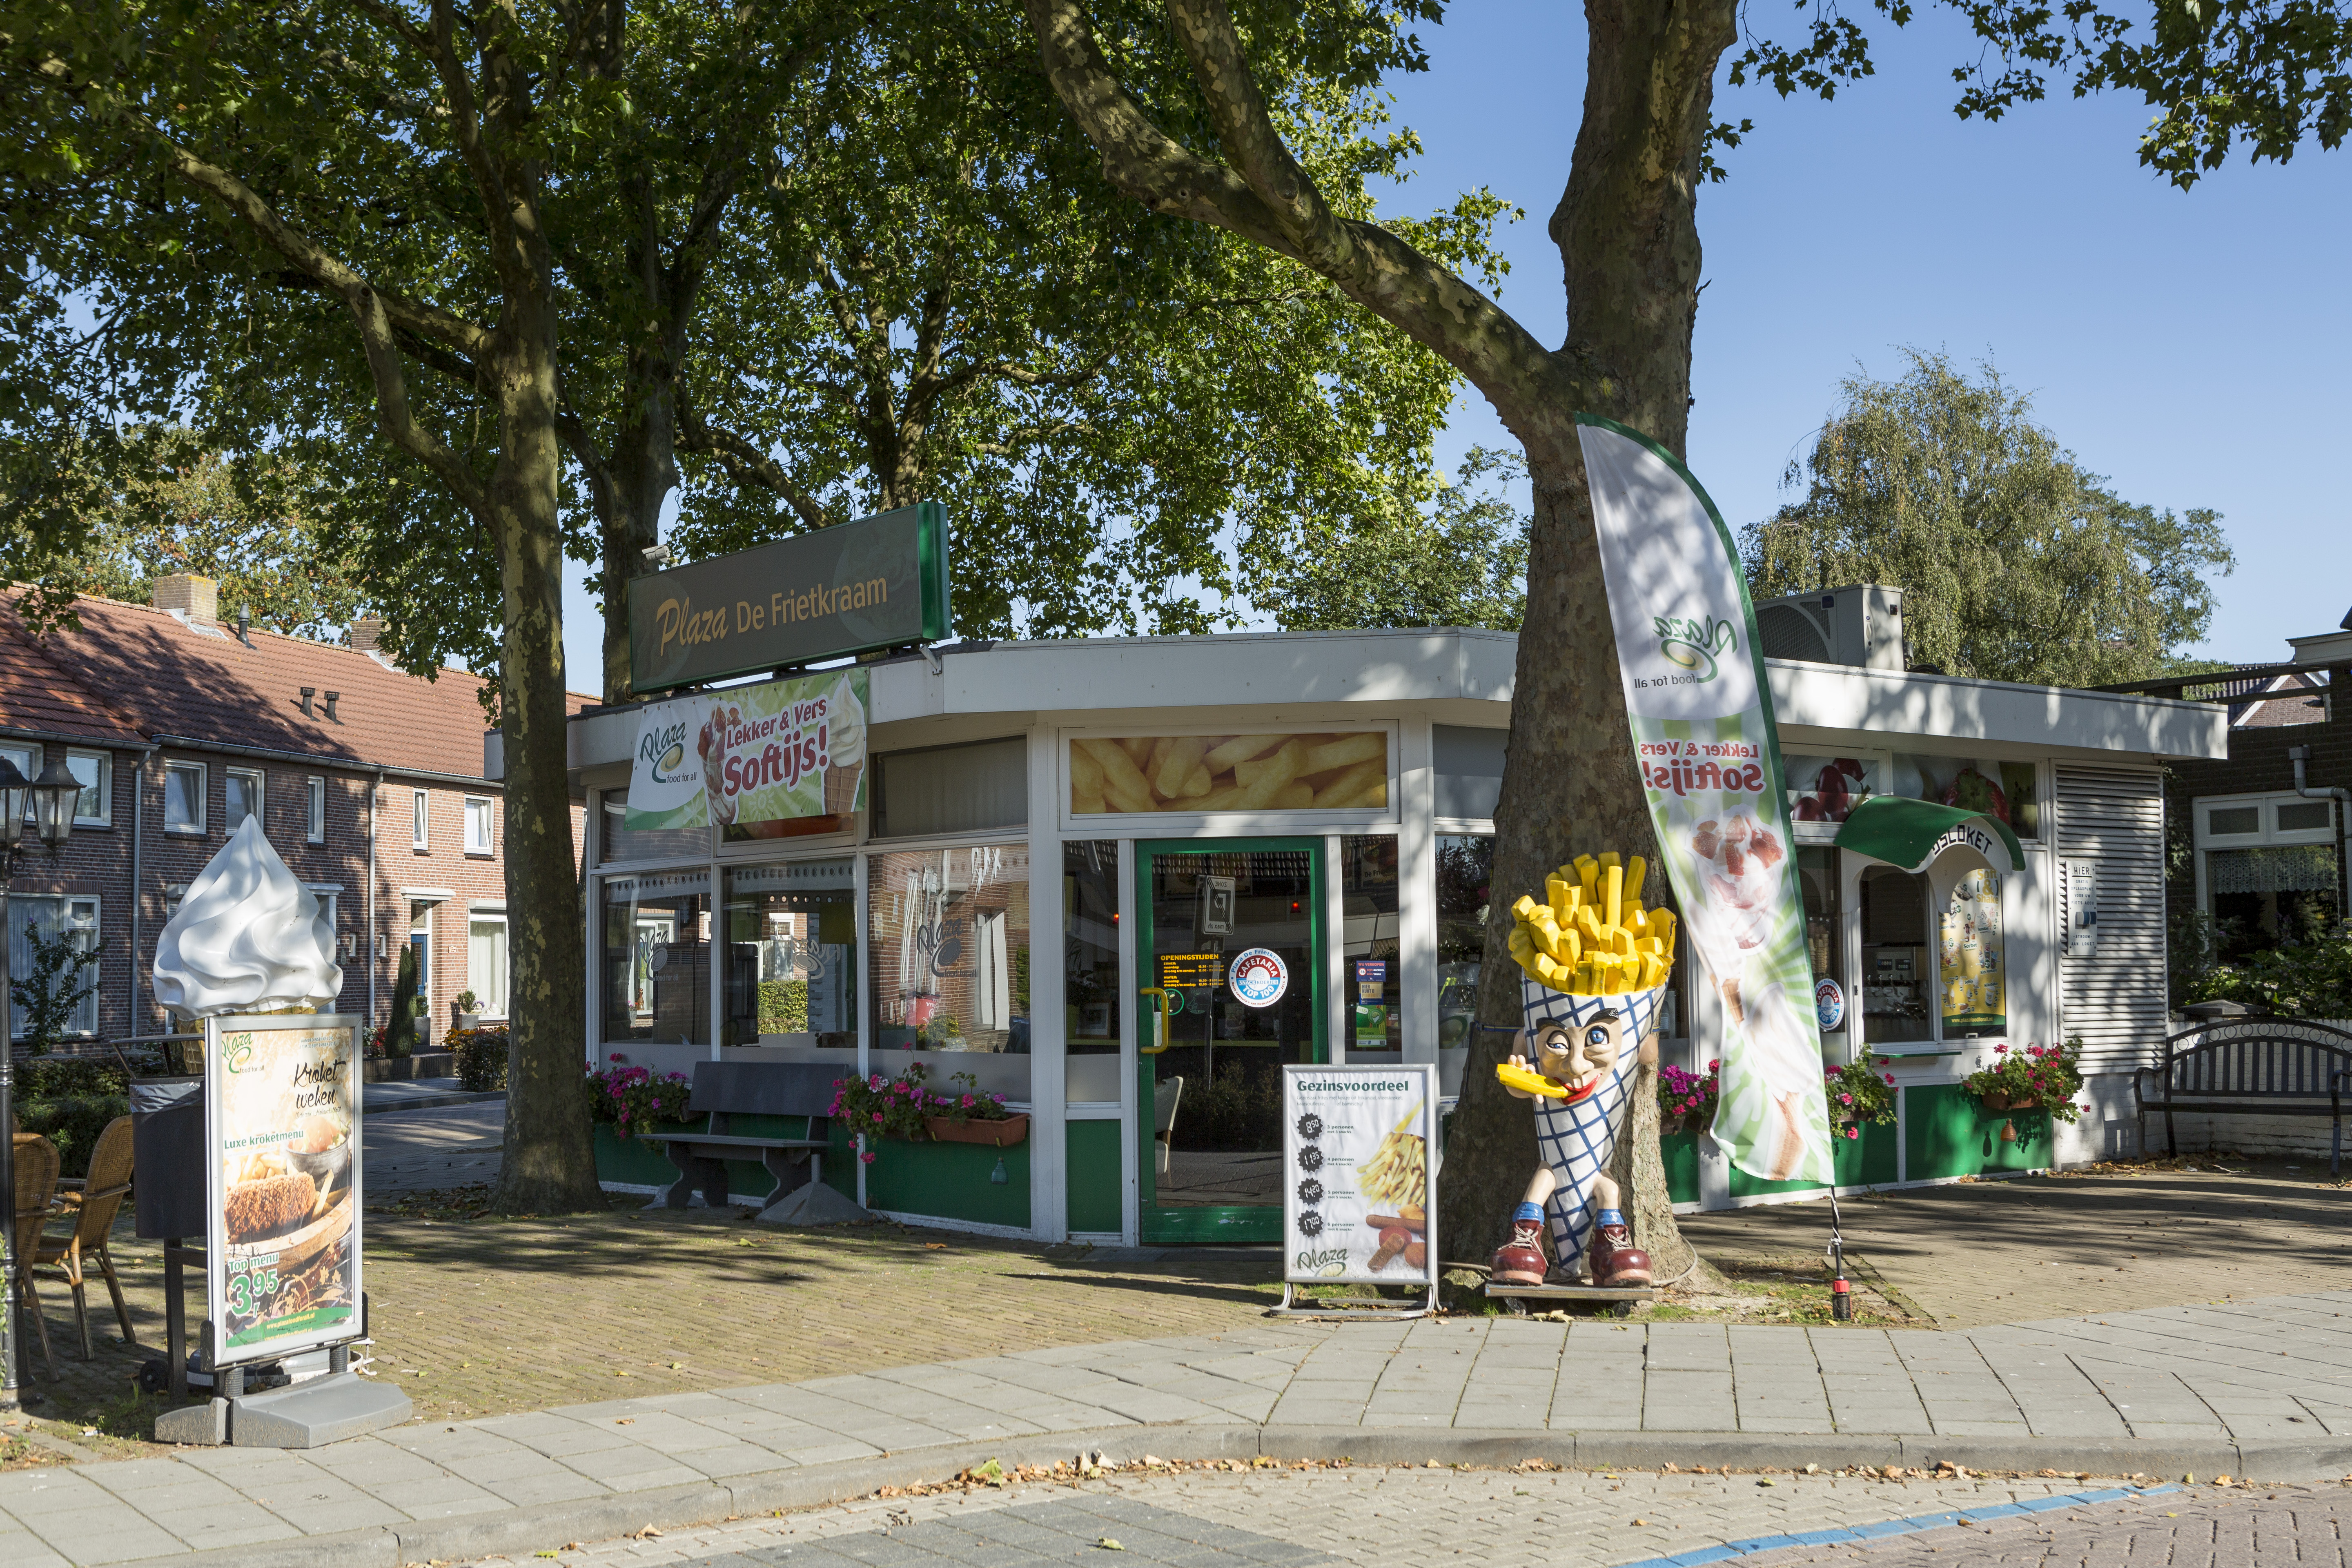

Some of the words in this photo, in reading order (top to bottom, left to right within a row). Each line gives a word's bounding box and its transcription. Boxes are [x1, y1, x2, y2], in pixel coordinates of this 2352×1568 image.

[656, 597, 728, 657] Plaza
[737, 601, 764, 633] De
[772, 577, 888, 626] Frietkraam
[726, 720, 777, 749] Lekker
[779, 710, 789, 731] &
[793, 698, 827, 727] Vers
[640, 720, 687, 762] Plaza
[722, 725, 828, 796] Softijs!
[666, 773, 681, 783] food
[1976, 894, 1999, 904] Shake
[917, 918, 964, 956] Plaza
[1231, 958, 1243, 973] Plaza
[1254, 949, 1285, 970] Frietkraam
[1238, 958, 1278, 978] CAFETARIA
[1243, 985, 1258, 998] TOP
[1260, 985, 1274, 998] 100
[1817, 987, 1838, 1005] CAFETARIA
[1820, 1012, 1829, 1022] TOP
[1829, 1010, 1838, 1021] 100
[294, 1059, 346, 1088] Kroket
[1297, 1080, 1408, 1091] Gezinsvoordeel
[296, 1085, 336, 1109] weken
[224, 1139, 247, 1149] Luxe
[249, 1130, 304, 1145] kroketmenu
[229, 1261, 247, 1272] Top
[250, 1253, 278, 1267] menu
[1297, 1248, 1348, 1272] Plaza
[267, 1312, 315, 1330] www.plazafoodforall.nl
[264, 1327, 312, 1341] wwwplazafoodforallnl
